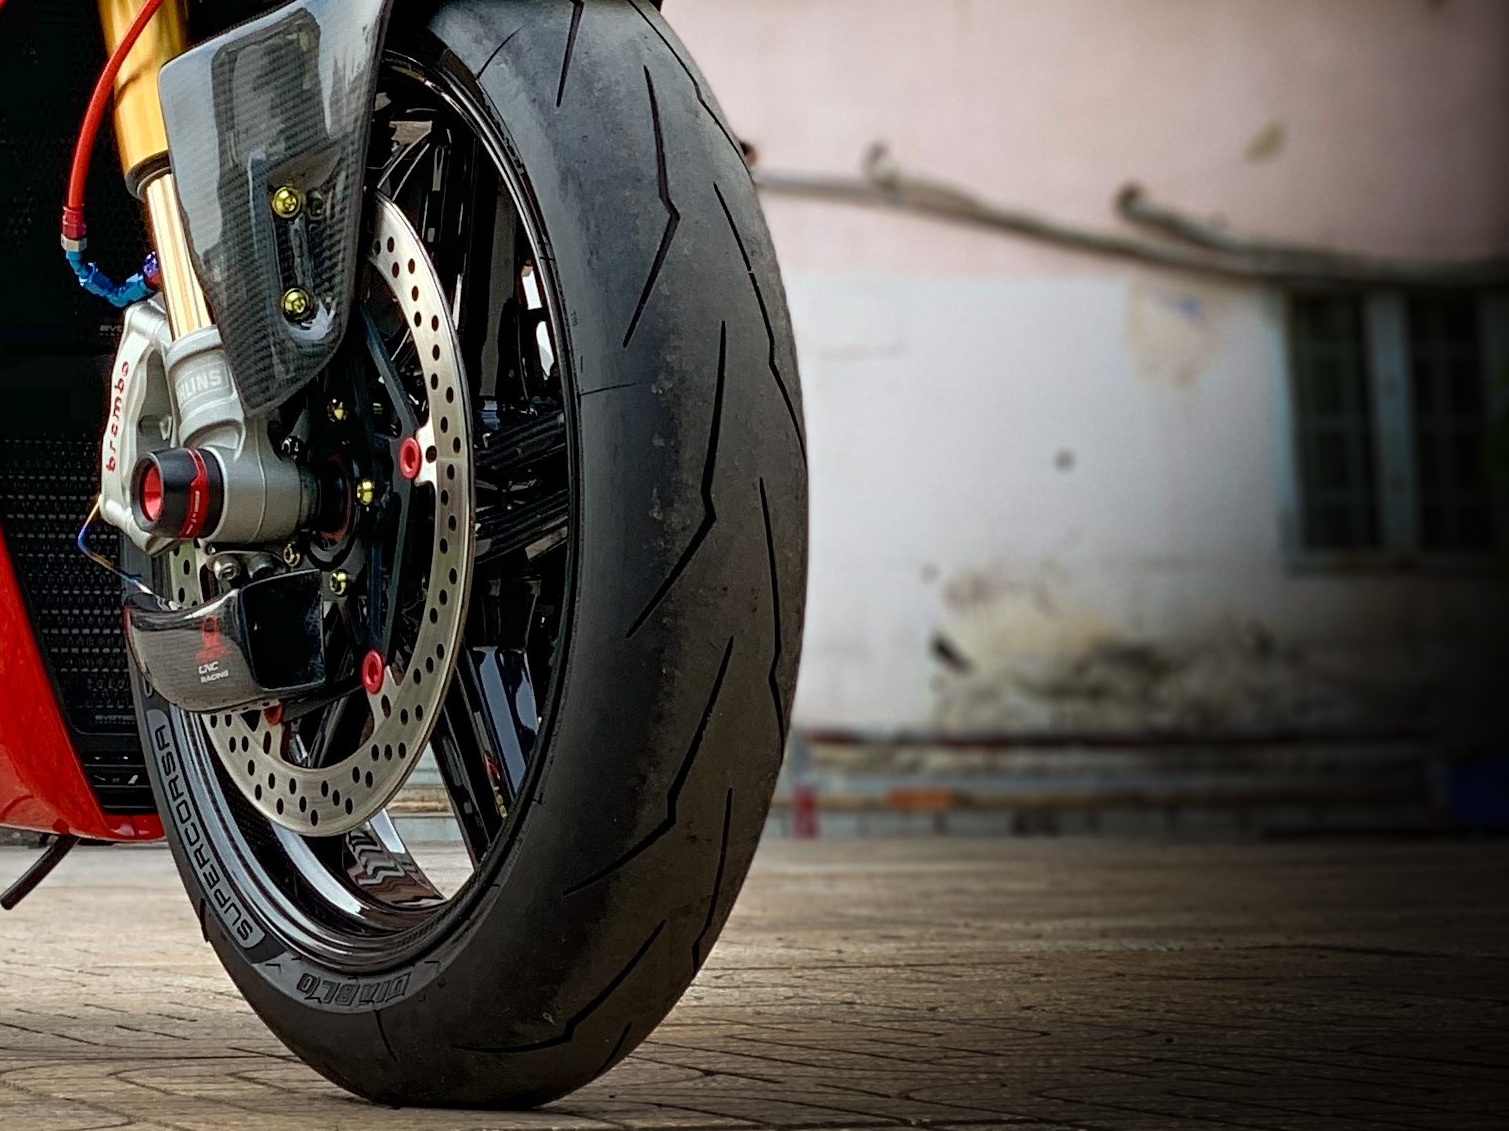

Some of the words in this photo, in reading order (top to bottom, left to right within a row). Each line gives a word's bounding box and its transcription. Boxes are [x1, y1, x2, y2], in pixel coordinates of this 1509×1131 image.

[105, 360, 130, 473] brembo
[198, 660, 219, 675] CNC
[200, 669, 230, 684] RACING
[153, 724, 255, 944] SUPERCORSA
[295, 971, 412, 1007] DIABLO
